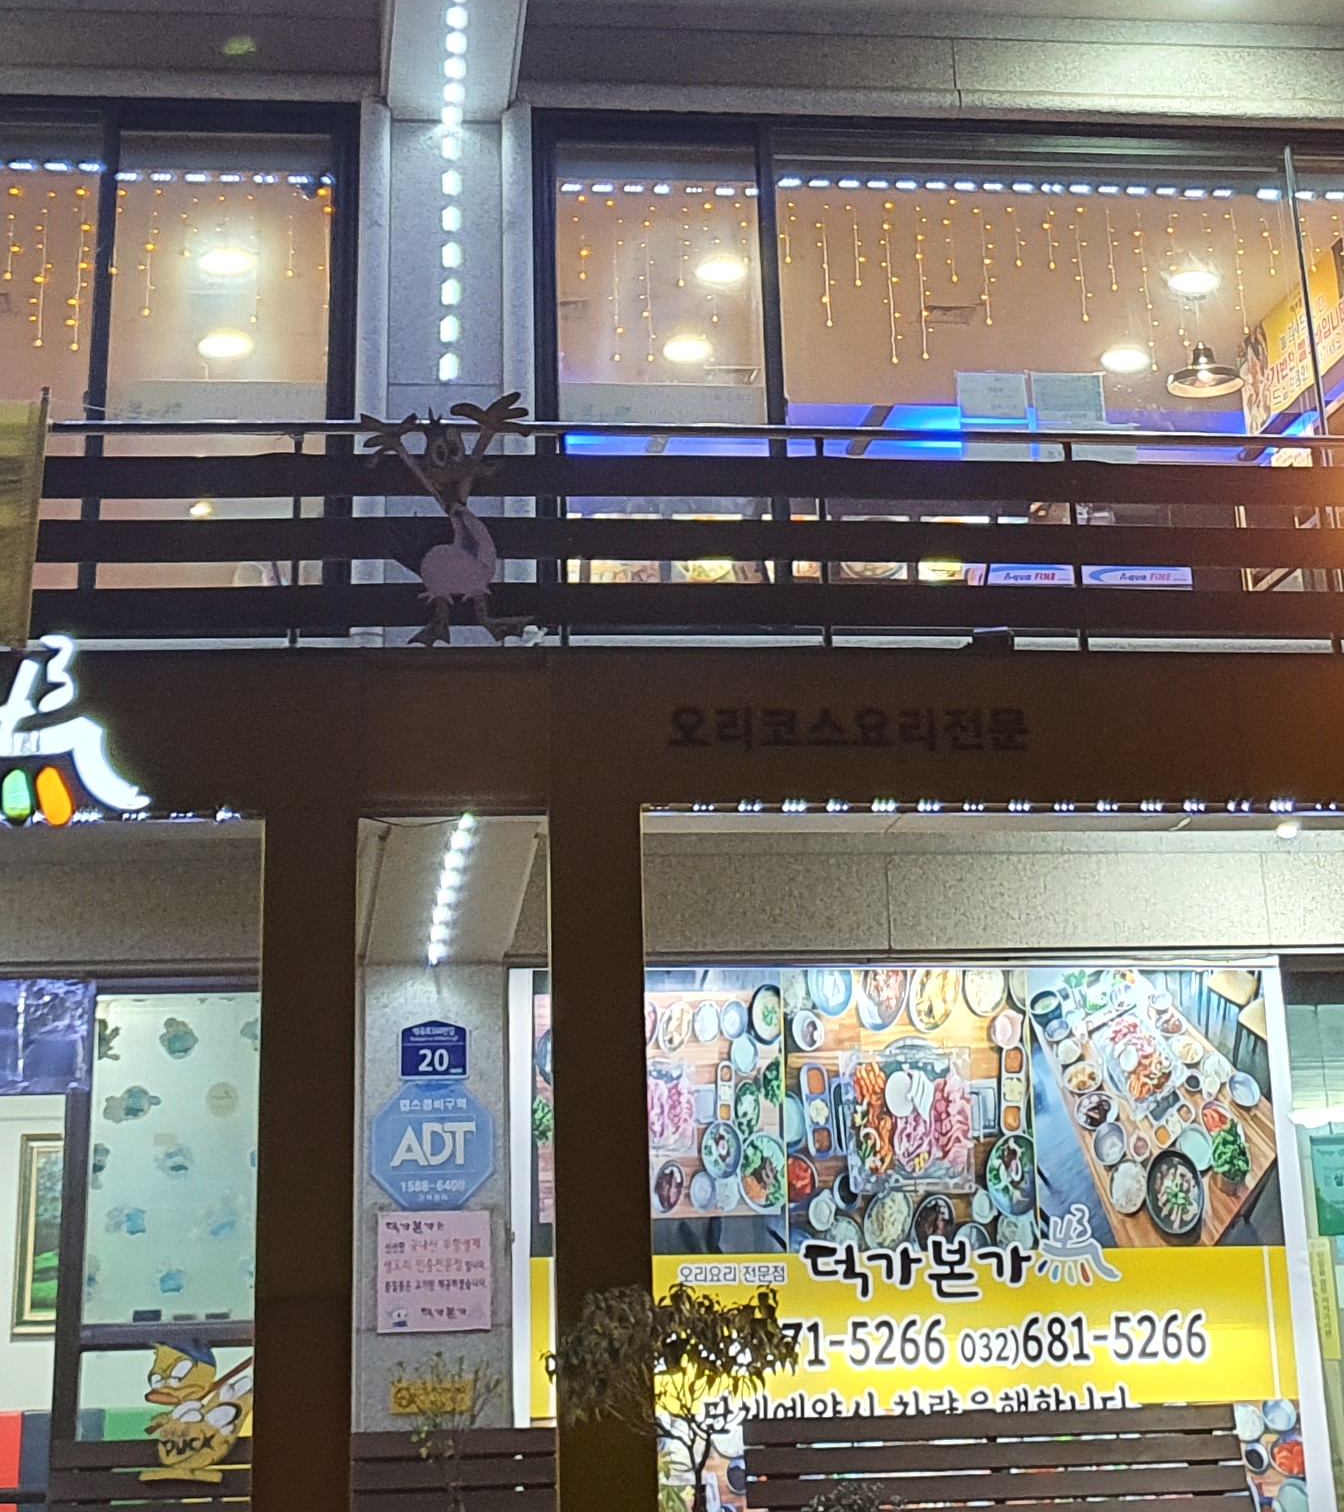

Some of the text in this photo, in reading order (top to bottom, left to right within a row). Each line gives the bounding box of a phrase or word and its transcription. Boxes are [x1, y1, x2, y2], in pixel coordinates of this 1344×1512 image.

[417, 1048, 450, 1073] 20
[389, 1121, 476, 1168] ADT
[679, 1264, 786, 1284] 오리요리 전문점
[803, 1239, 1032, 1299] 덕가본가
